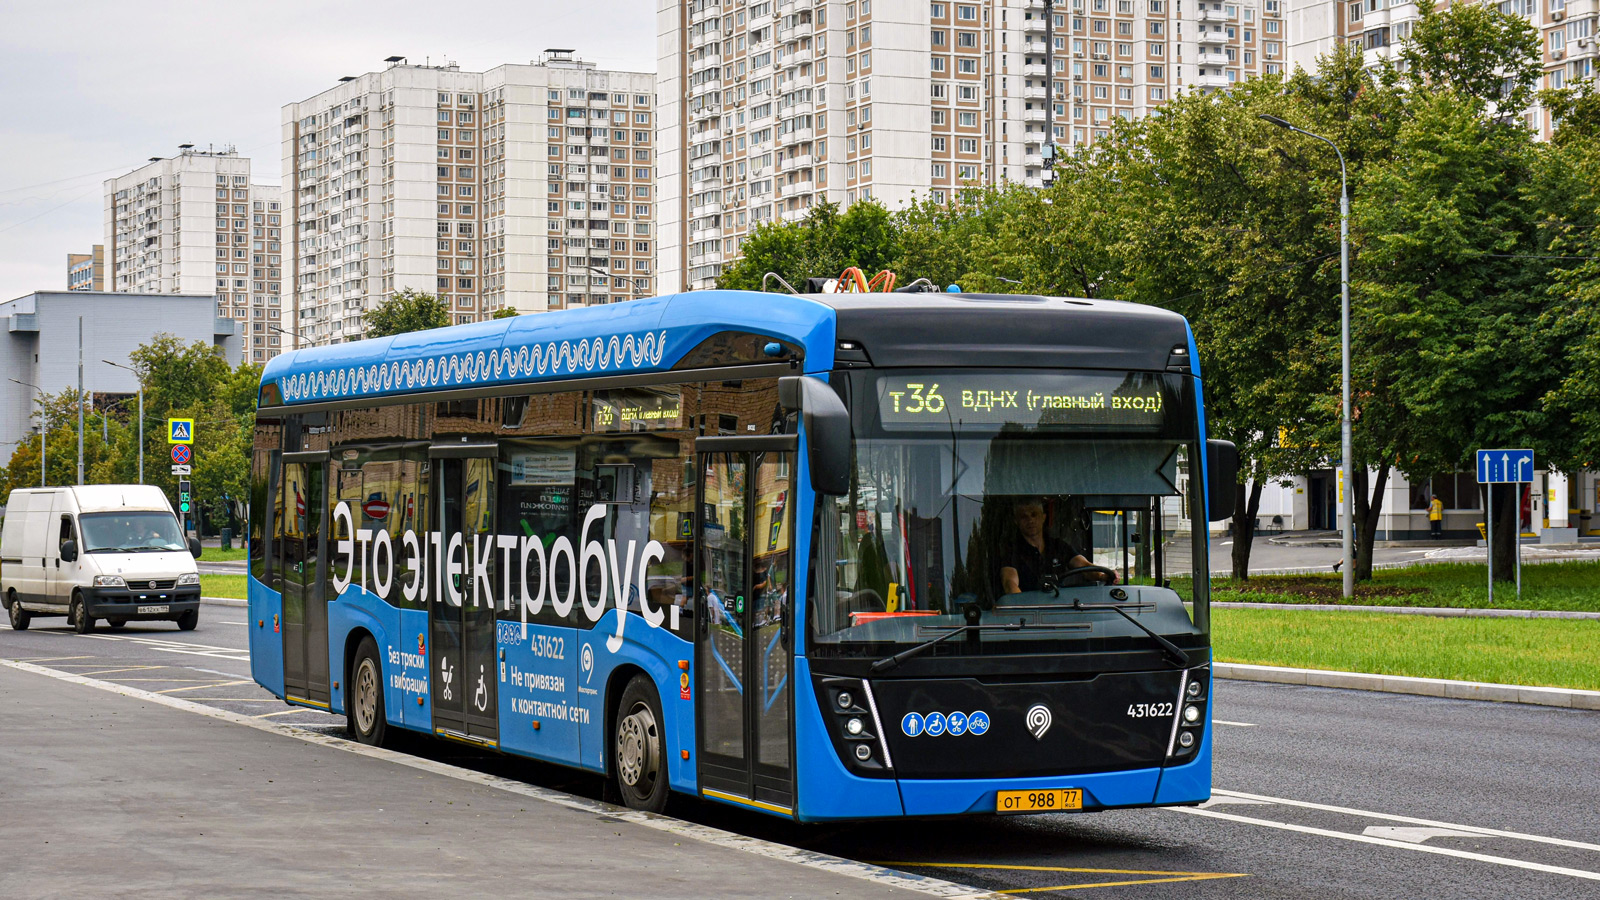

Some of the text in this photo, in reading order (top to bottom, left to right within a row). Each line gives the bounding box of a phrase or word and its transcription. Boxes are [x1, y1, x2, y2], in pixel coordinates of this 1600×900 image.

[889, 383, 1162, 413] т36 ВДНХ (главный вход)
[332, 501, 394, 599] Это
[388, 645, 425, 670] Без тряски
[531, 634, 564, 660] 431622
[394, 671, 428, 695] вибраций
[511, 665, 565, 692] Не привязан
[511, 698, 590, 724] к контактной сети
[1127, 702, 1173, 718] 431622
[1004, 791, 1077, 808] ОТ 988 77
